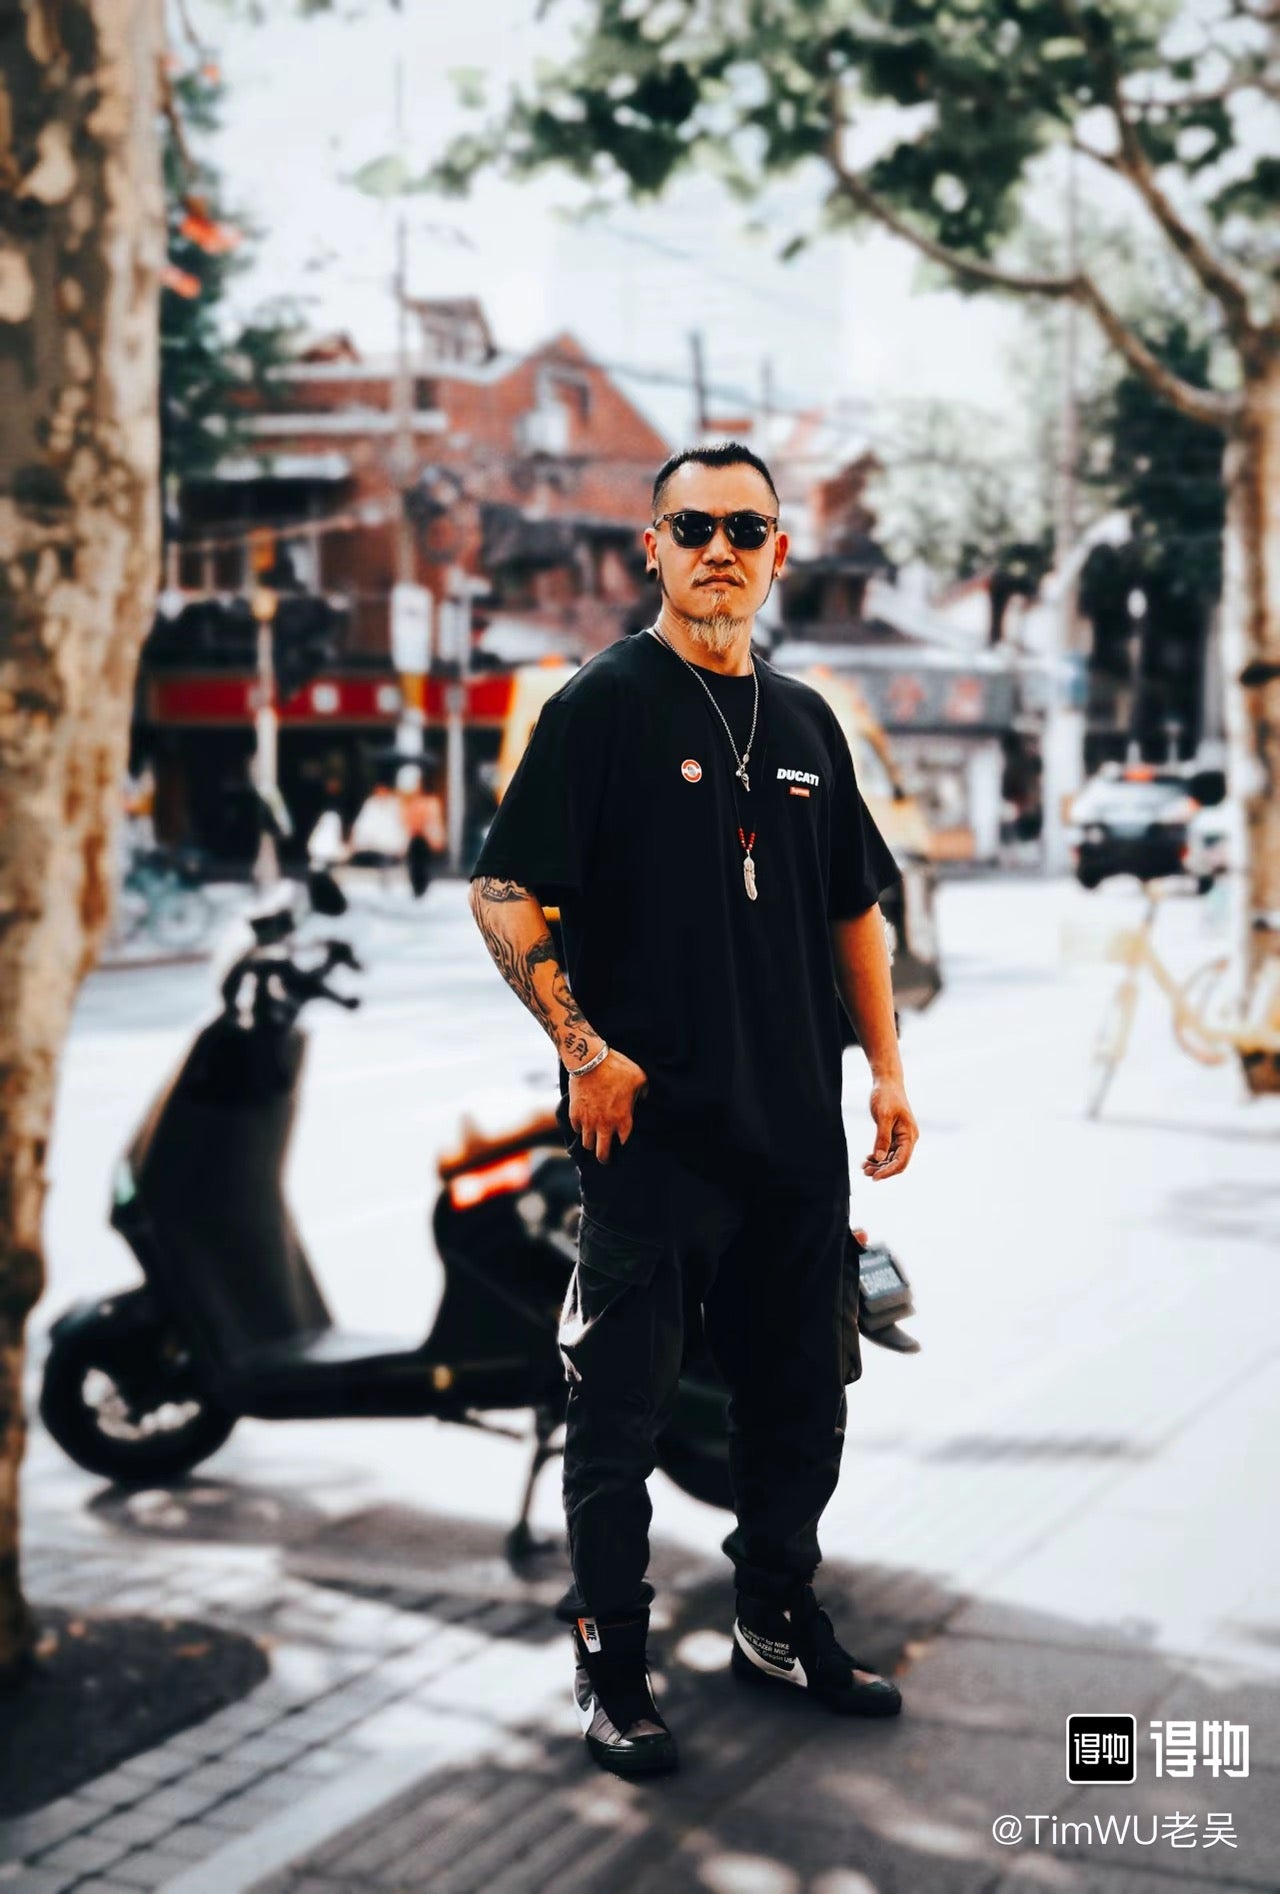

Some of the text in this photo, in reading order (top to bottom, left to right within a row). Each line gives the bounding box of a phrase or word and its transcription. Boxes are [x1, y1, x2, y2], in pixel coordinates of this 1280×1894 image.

[776, 768, 820, 787] DUCATI
[585, 1624, 597, 1640] NIKE
[774, 1642, 790, 1650] NIKE
